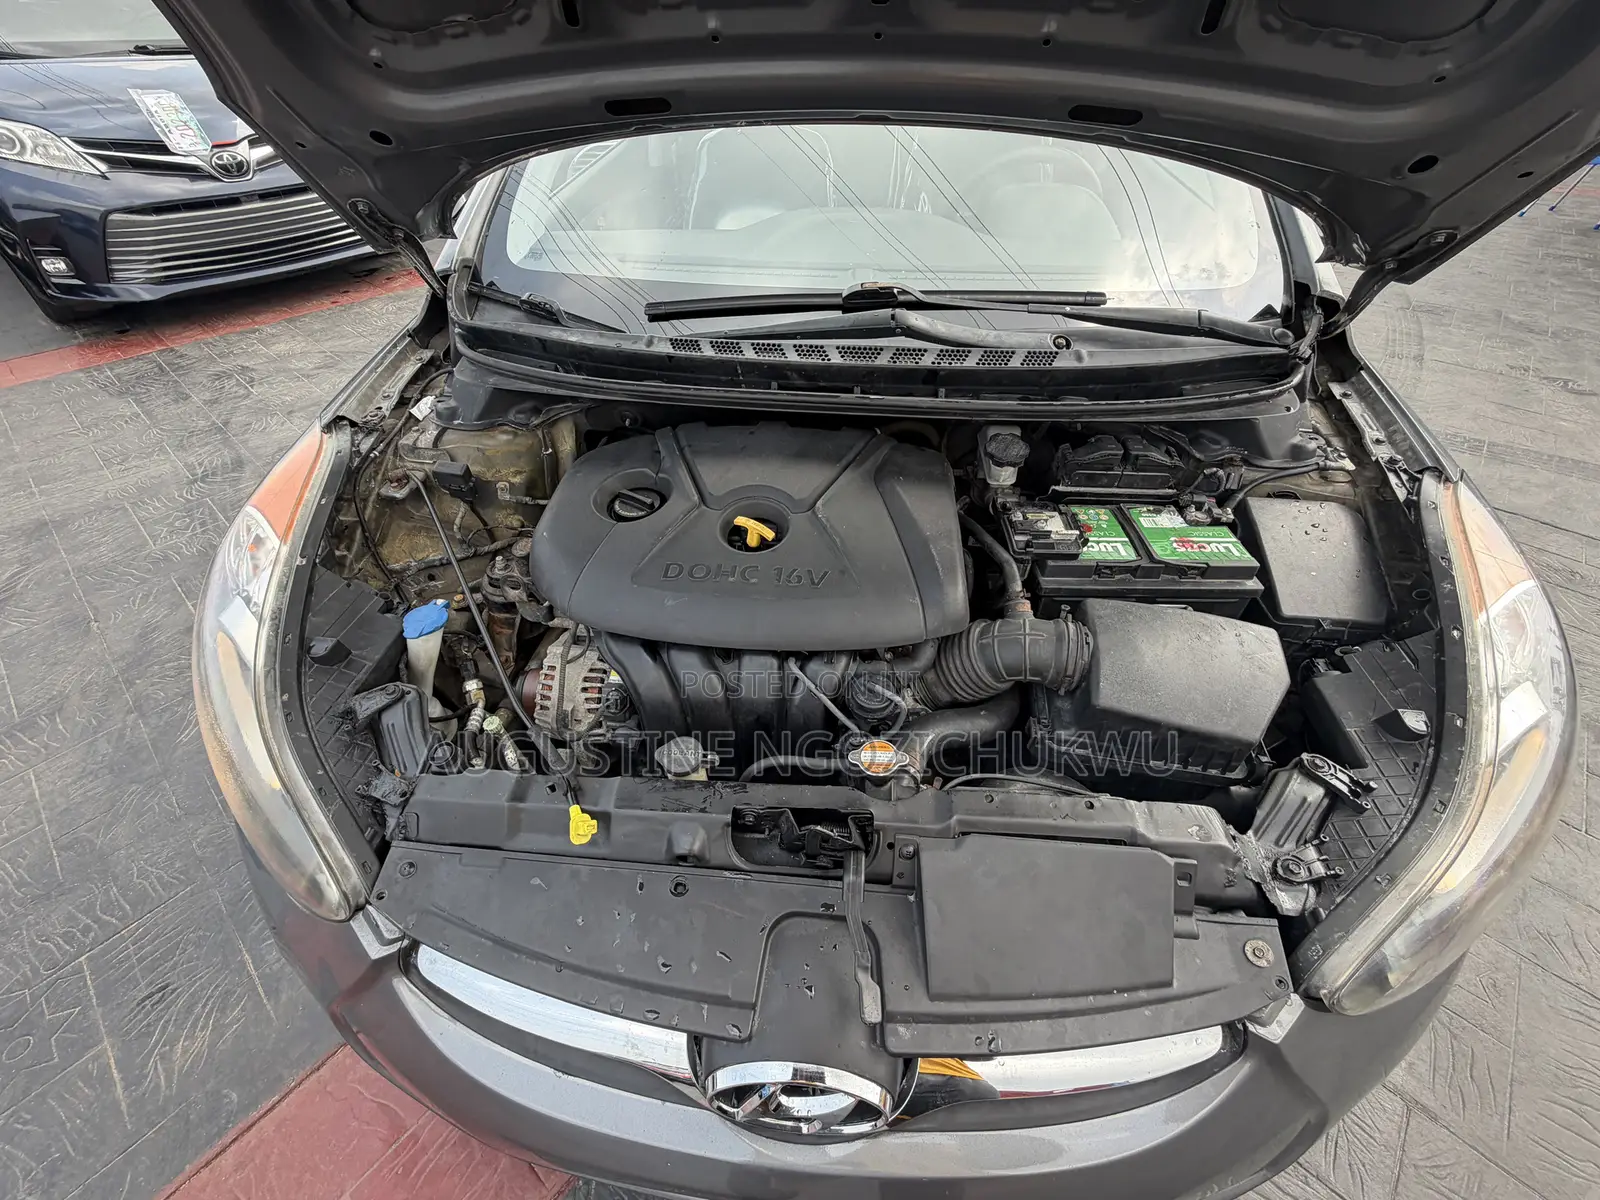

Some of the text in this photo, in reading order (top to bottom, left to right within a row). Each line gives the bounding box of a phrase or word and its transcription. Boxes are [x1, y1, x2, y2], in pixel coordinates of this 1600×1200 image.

[661, 562, 831, 588] DOHC 16V
[663, 750, 702, 759] COOLANT
